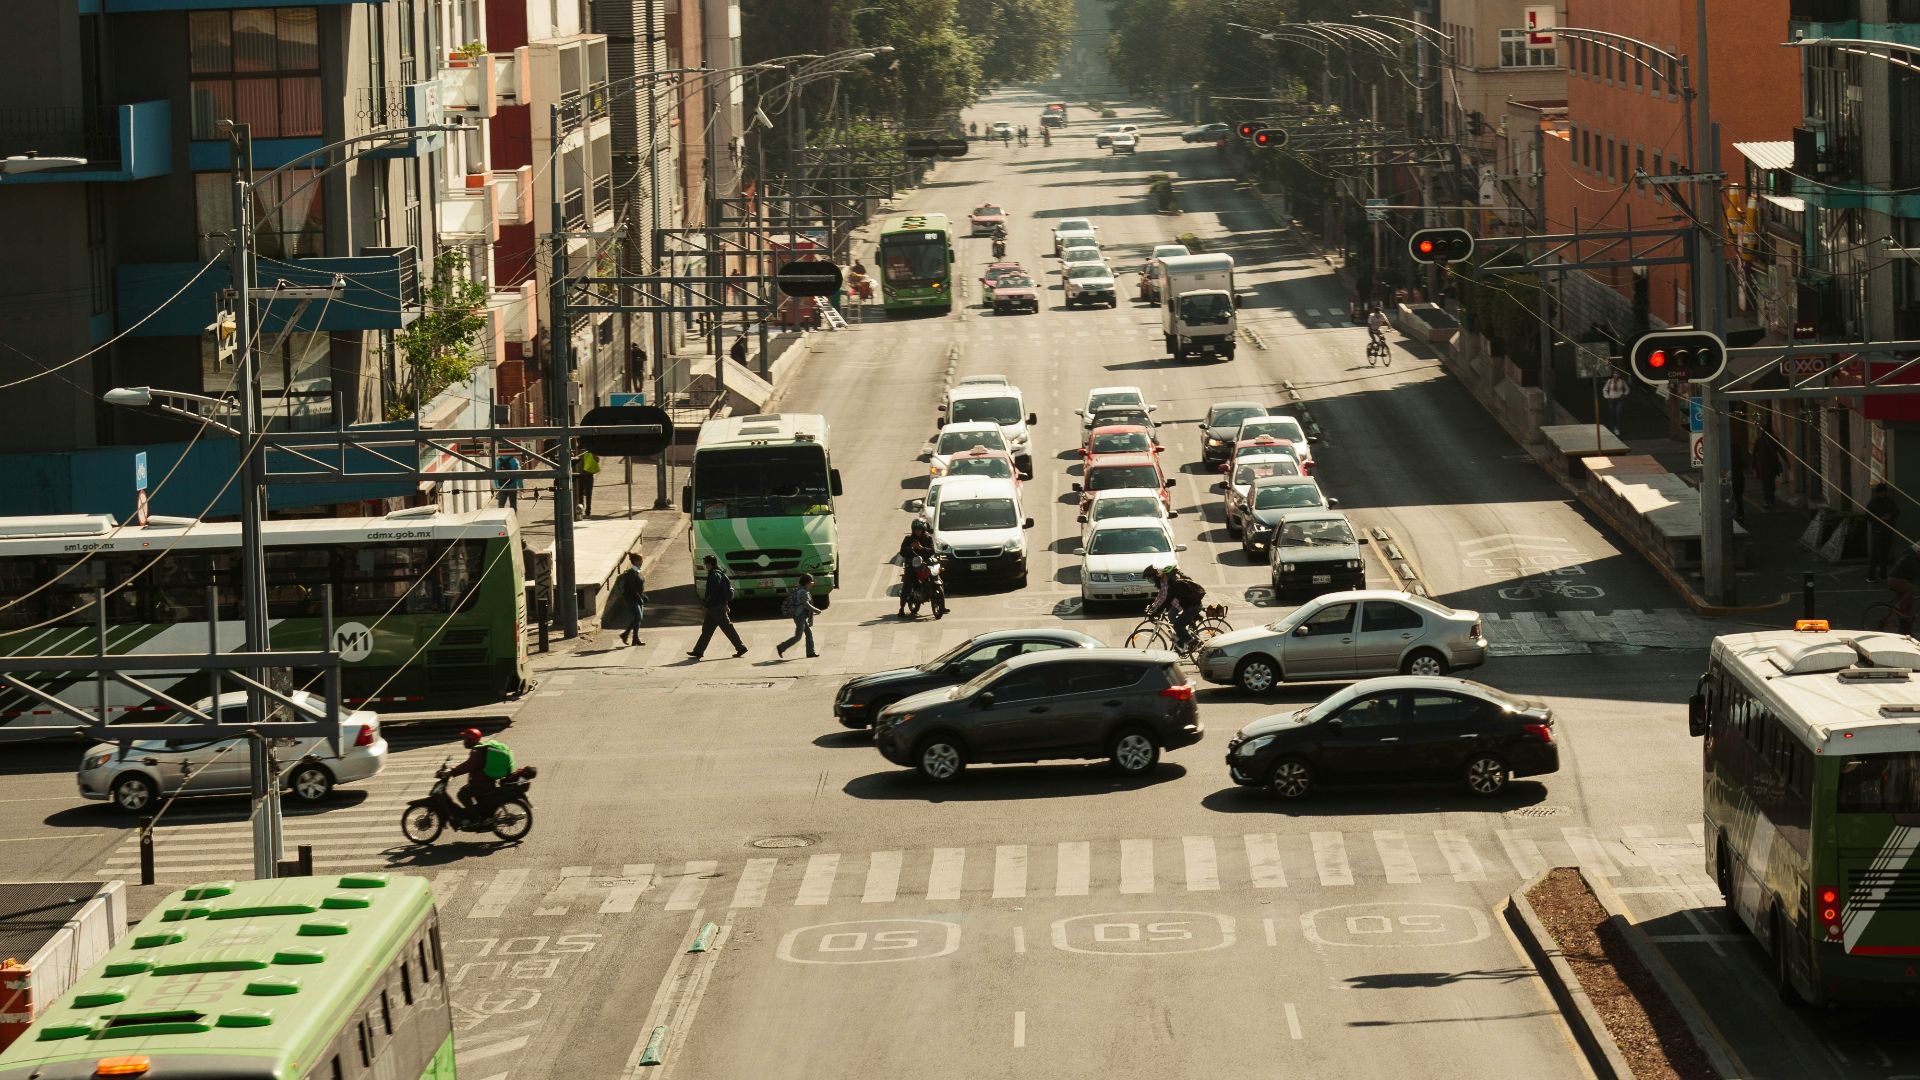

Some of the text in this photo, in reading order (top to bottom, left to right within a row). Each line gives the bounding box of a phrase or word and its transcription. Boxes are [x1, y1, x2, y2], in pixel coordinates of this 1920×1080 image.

[1784, 359, 1826, 374] OXXO
[367, 530, 431, 540] cdmx.gob.mx
[1463, 554, 1592, 568] SOLO
[337, 631, 369, 652] M1
[1094, 921, 1192, 942] 50
[1345, 915, 1445, 934] 50
[441, 933, 603, 957] SOL
[818, 930, 920, 952] 50
[443, 957, 561, 984] BU
